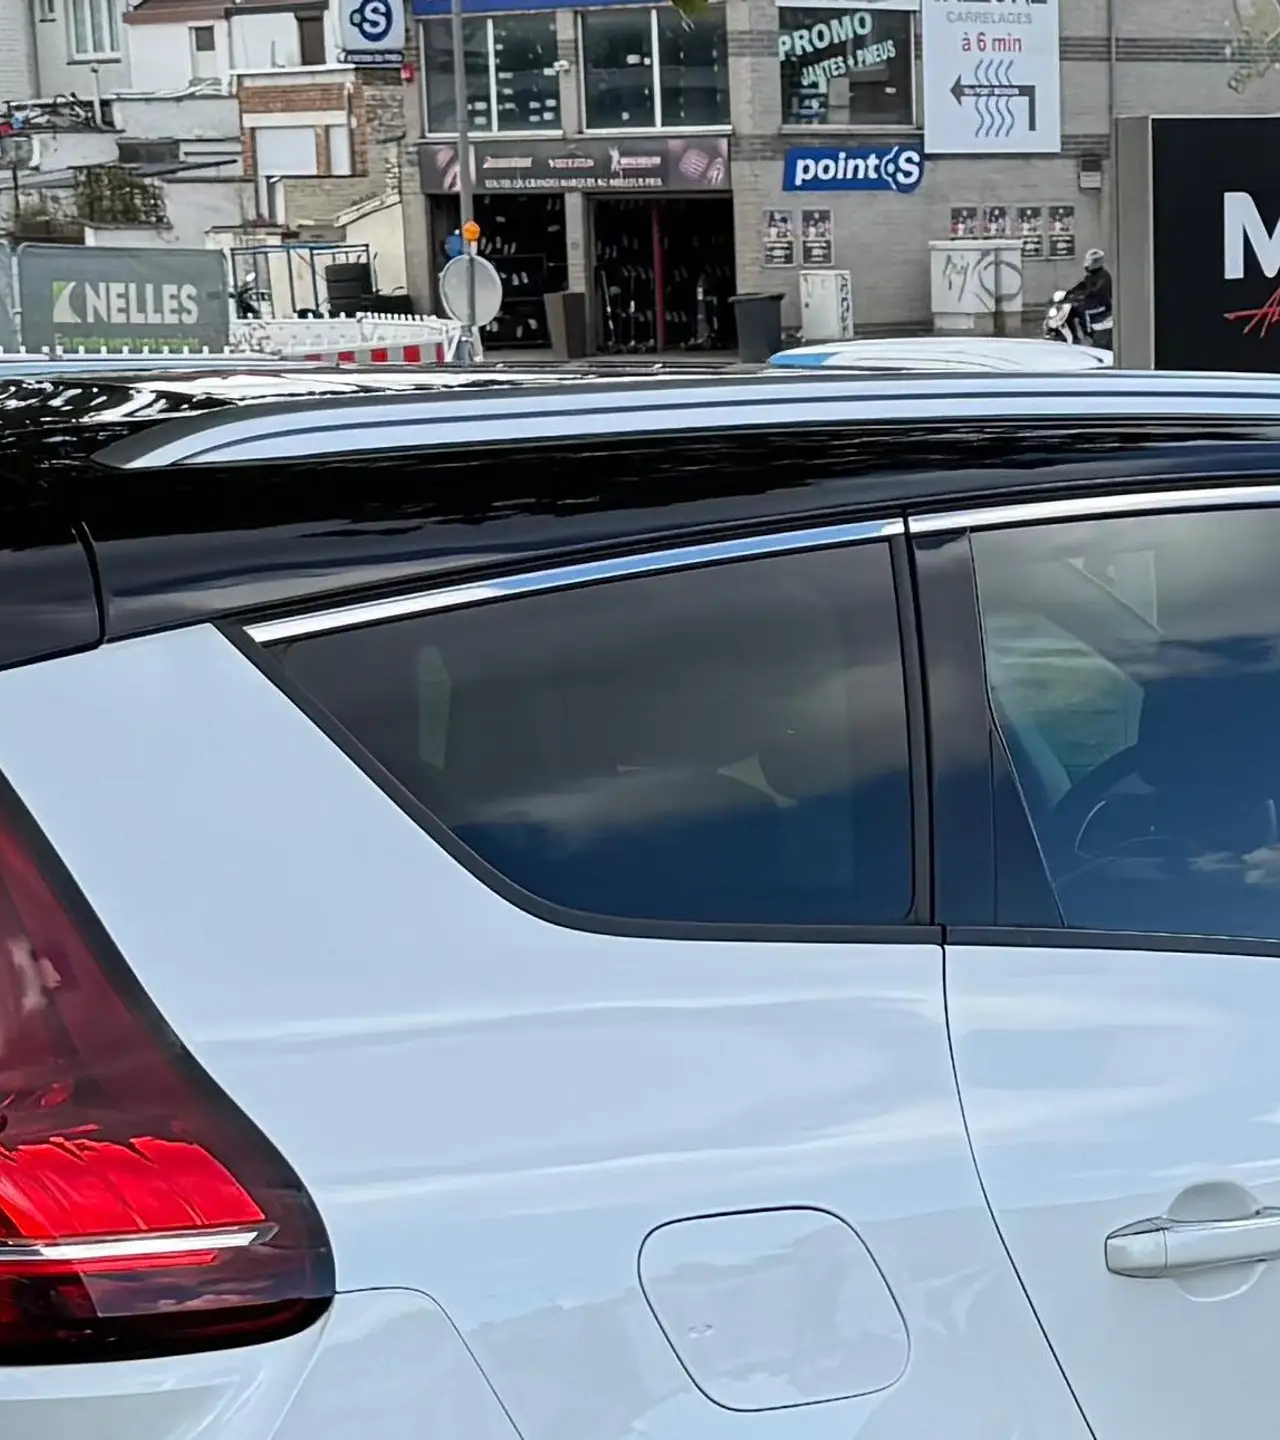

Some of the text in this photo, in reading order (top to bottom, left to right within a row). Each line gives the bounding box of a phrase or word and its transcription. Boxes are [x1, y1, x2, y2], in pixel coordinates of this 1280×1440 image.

[778, 11, 873, 61] PROMO
[945, 11, 1033, 25] CARRELAGES
[800, 56, 847, 86] JANTES
[855, 39, 897, 68] PNEUS
[961, 32, 1022, 53] à 6 min
[84, 281, 200, 324] NELLES
